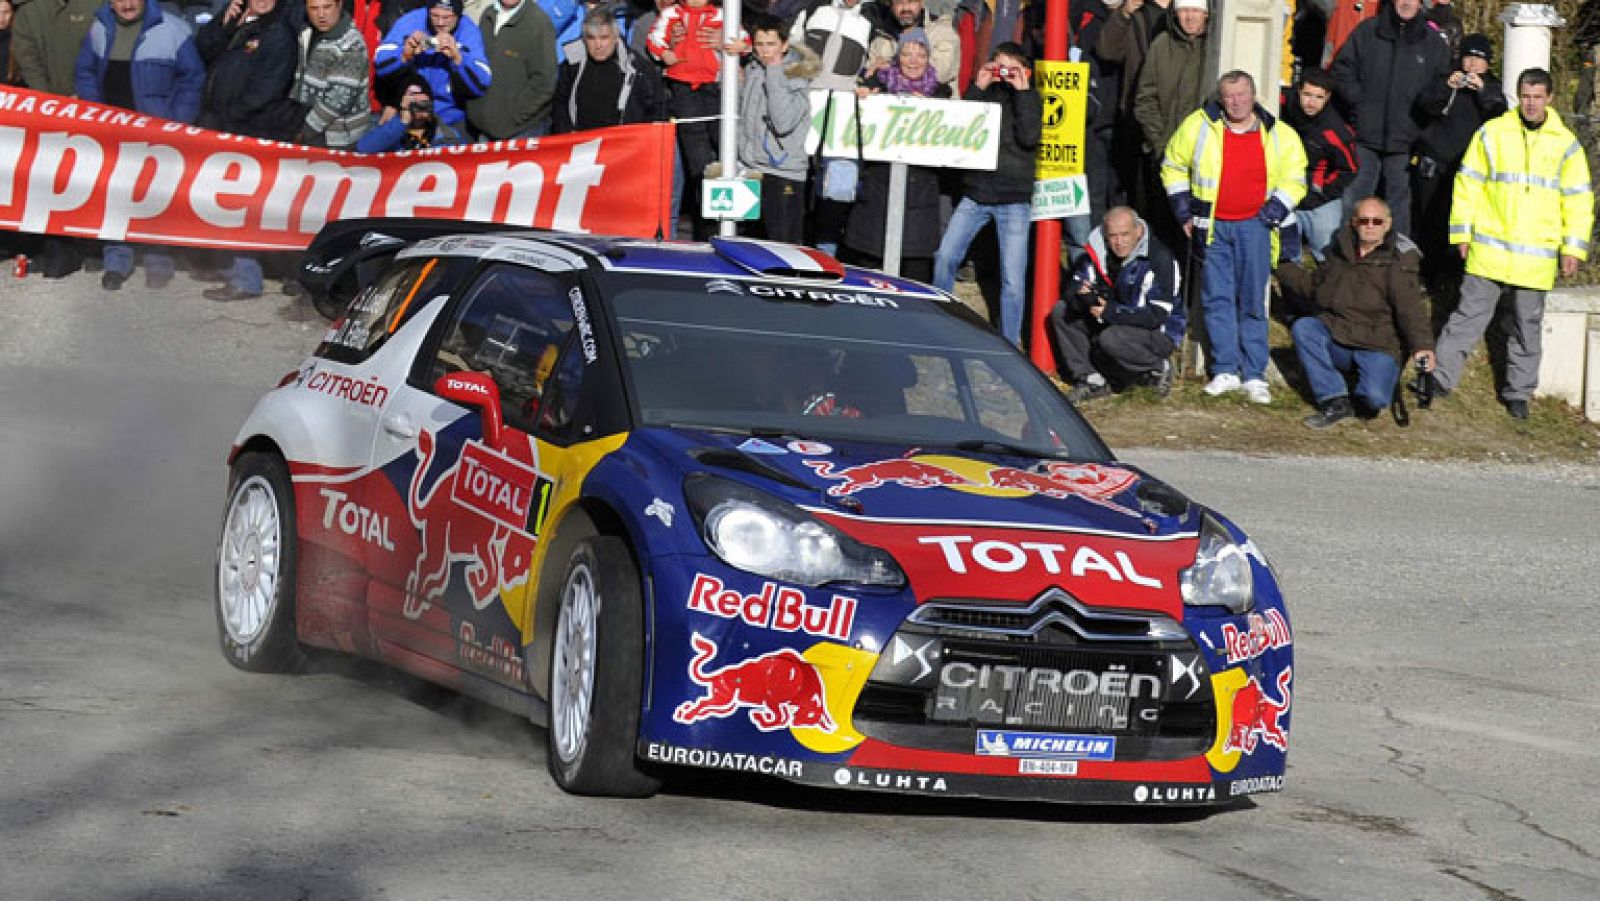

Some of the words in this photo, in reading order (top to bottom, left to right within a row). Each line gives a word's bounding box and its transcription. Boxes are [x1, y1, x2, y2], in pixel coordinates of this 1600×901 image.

[0, 91, 151, 128] MAGAZINE
[879, 104, 990, 153] Tilleuls
[447, 378, 490, 395] TOTAL
[464, 456, 525, 517] TOTAL
[319, 487, 396, 552] TOTAL
[917, 534, 1164, 590] TOTAL
[935, 694, 1160, 724] RACING
[647, 743, 803, 777] EURODATACAR
[1012, 737, 1109, 754] MICHELIN
[857, 771, 947, 791] LUHTA
[1151, 786, 1217, 801] LUHTA
